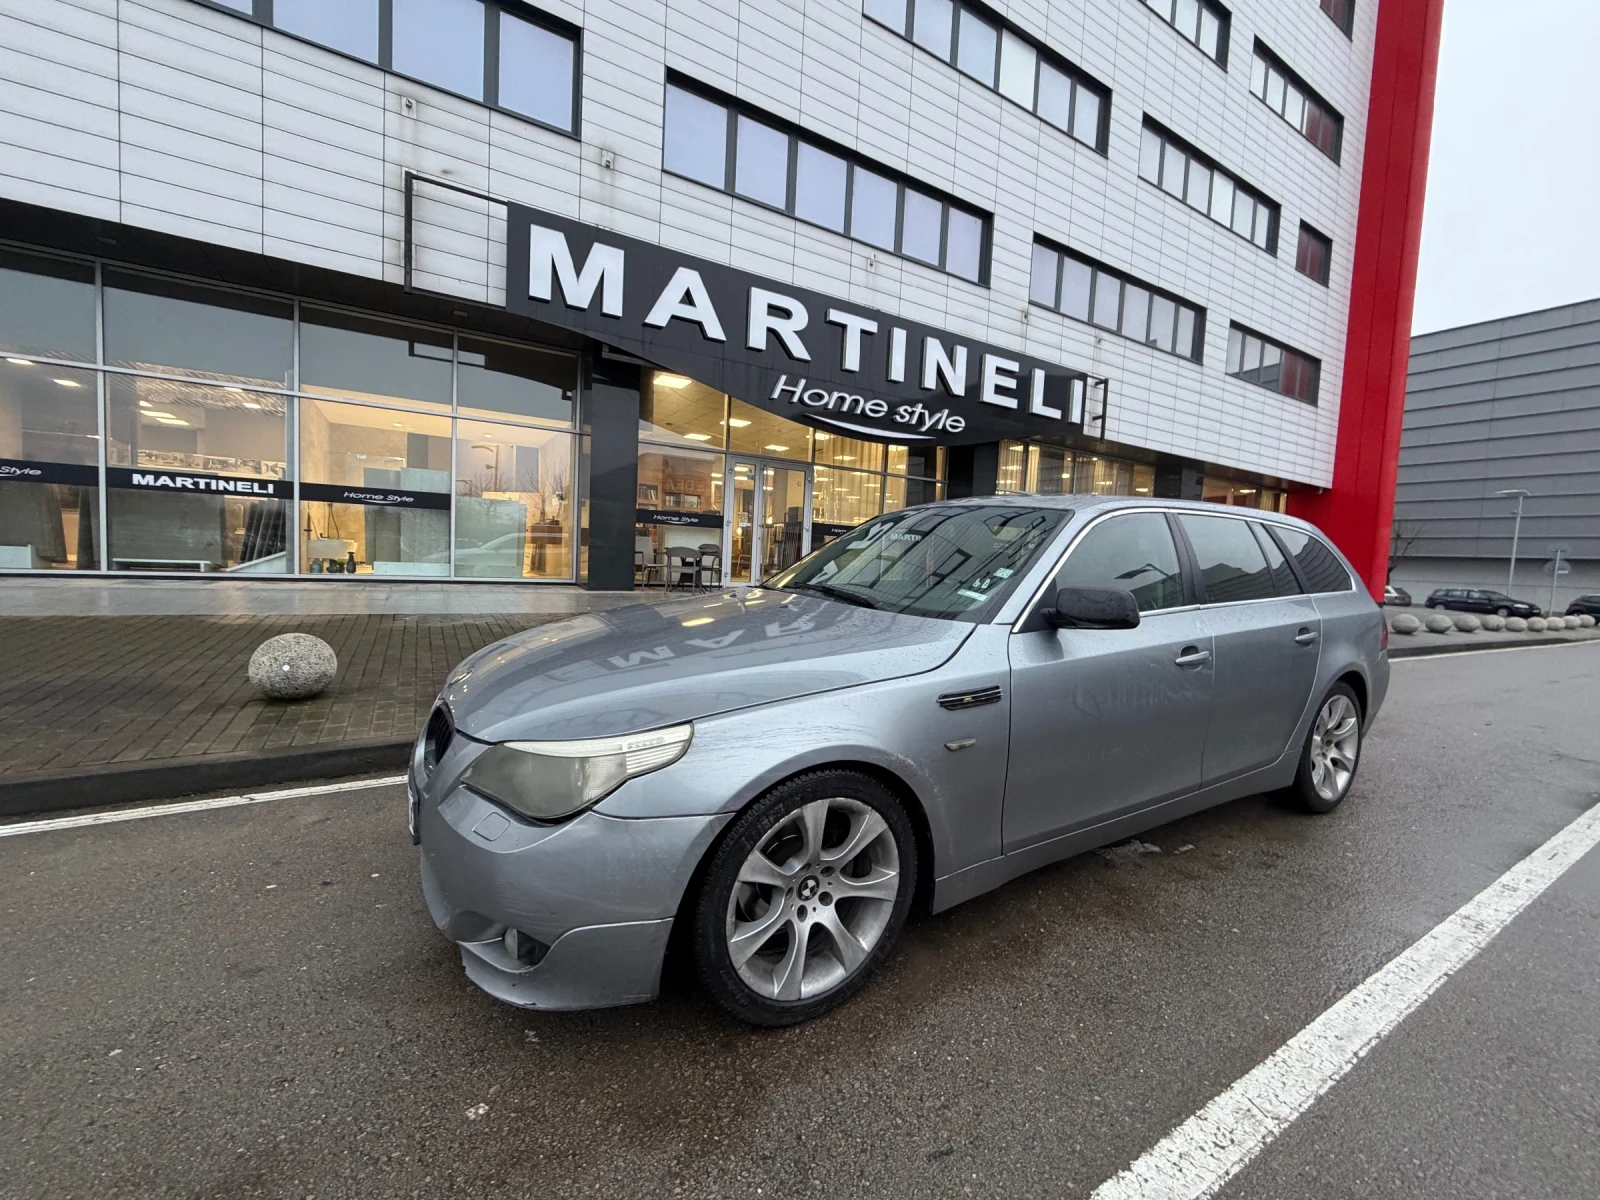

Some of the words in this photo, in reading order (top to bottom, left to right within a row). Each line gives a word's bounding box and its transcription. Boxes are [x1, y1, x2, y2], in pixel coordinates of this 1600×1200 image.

[528, 223, 1084, 424] MARTINELI
[770, 374, 888, 417] Home
[893, 402, 966, 432] style
[132, 473, 274, 494] MARTINELI
[343, 491, 384, 500] Home
[386, 494, 415, 503] Style
